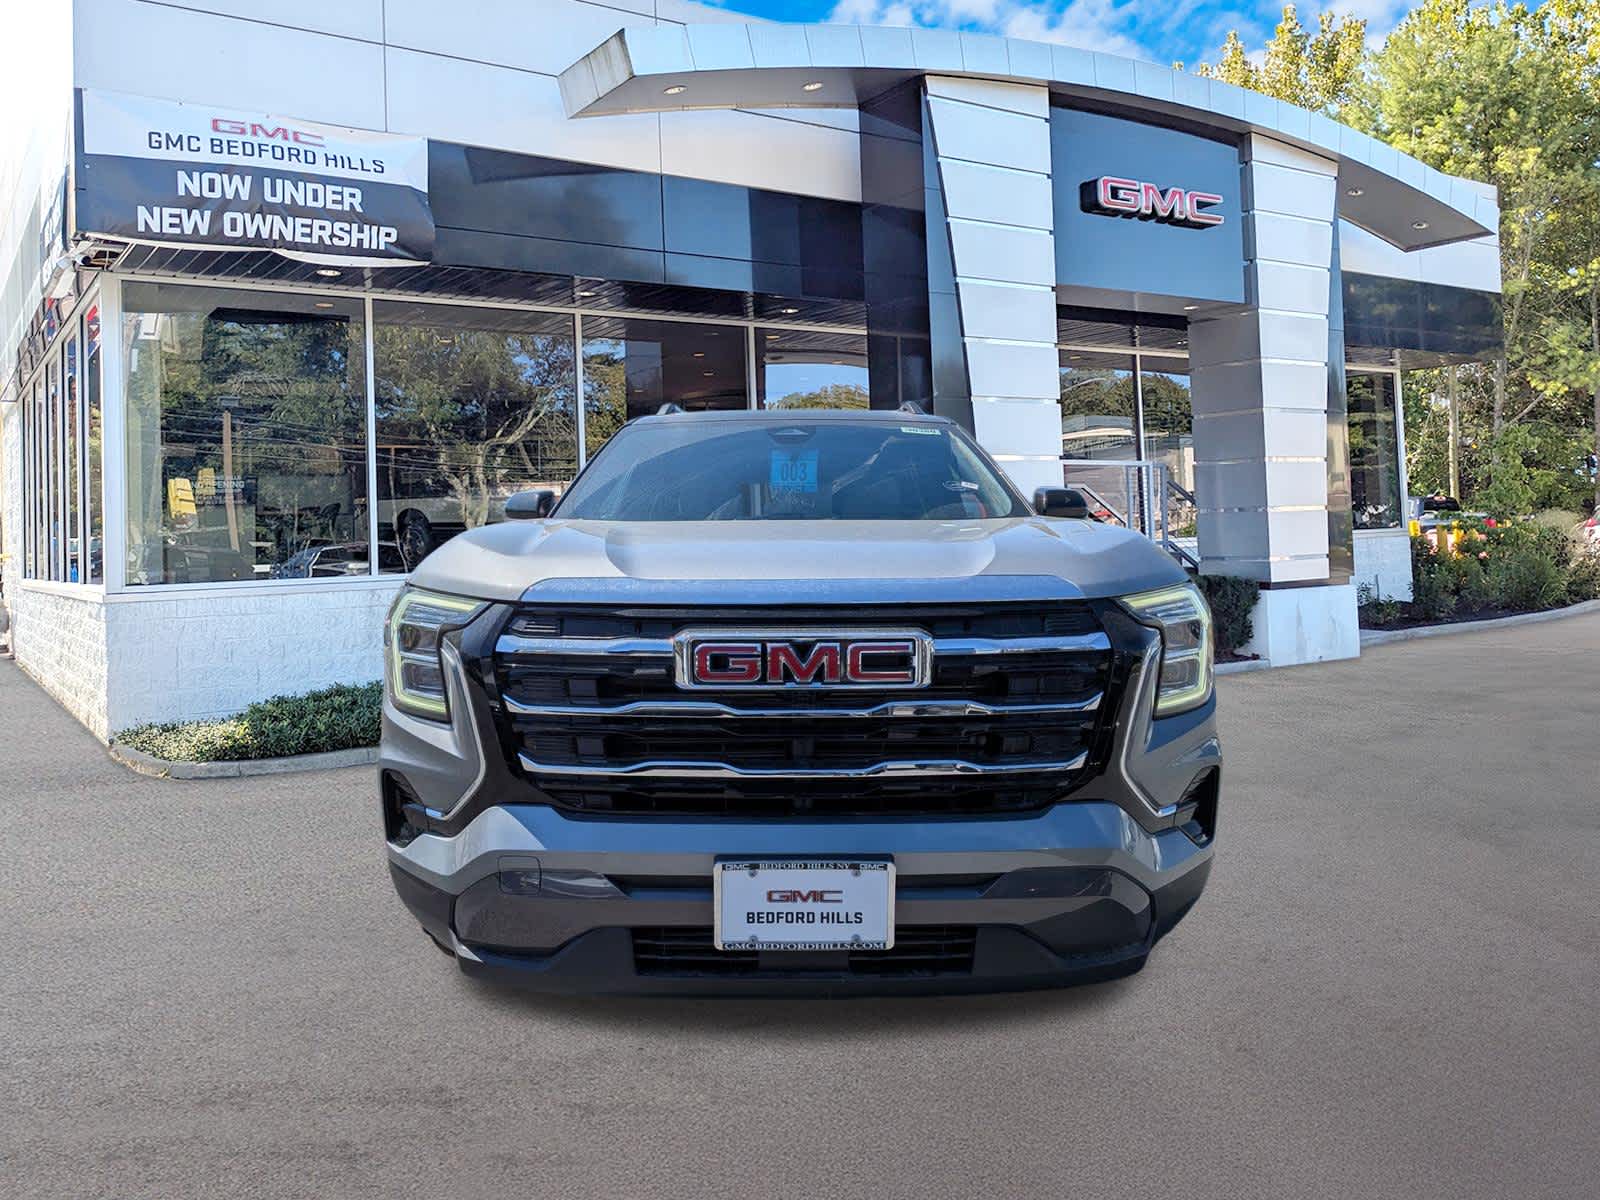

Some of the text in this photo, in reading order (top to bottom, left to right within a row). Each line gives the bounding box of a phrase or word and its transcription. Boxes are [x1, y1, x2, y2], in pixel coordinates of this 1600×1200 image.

[211, 118, 326, 148] GMC
[148, 131, 385, 174] GMC BEDFORD HILLS
[177, 170, 364, 213] NOW UNDER
[1096, 175, 1225, 225] GMC
[136, 205, 398, 250] NEW OWNERSHIP
[780, 463, 808, 481] 003
[694, 641, 914, 684] GMC
[725, 863, 751, 872] GMC
[759, 862, 805, 870] BEDFORD
[807, 862, 834, 870] HILLS
[859, 863, 886, 872] GMC
[766, 889, 844, 904] GMC
[746, 911, 863, 925] BEDFORD HILLS
